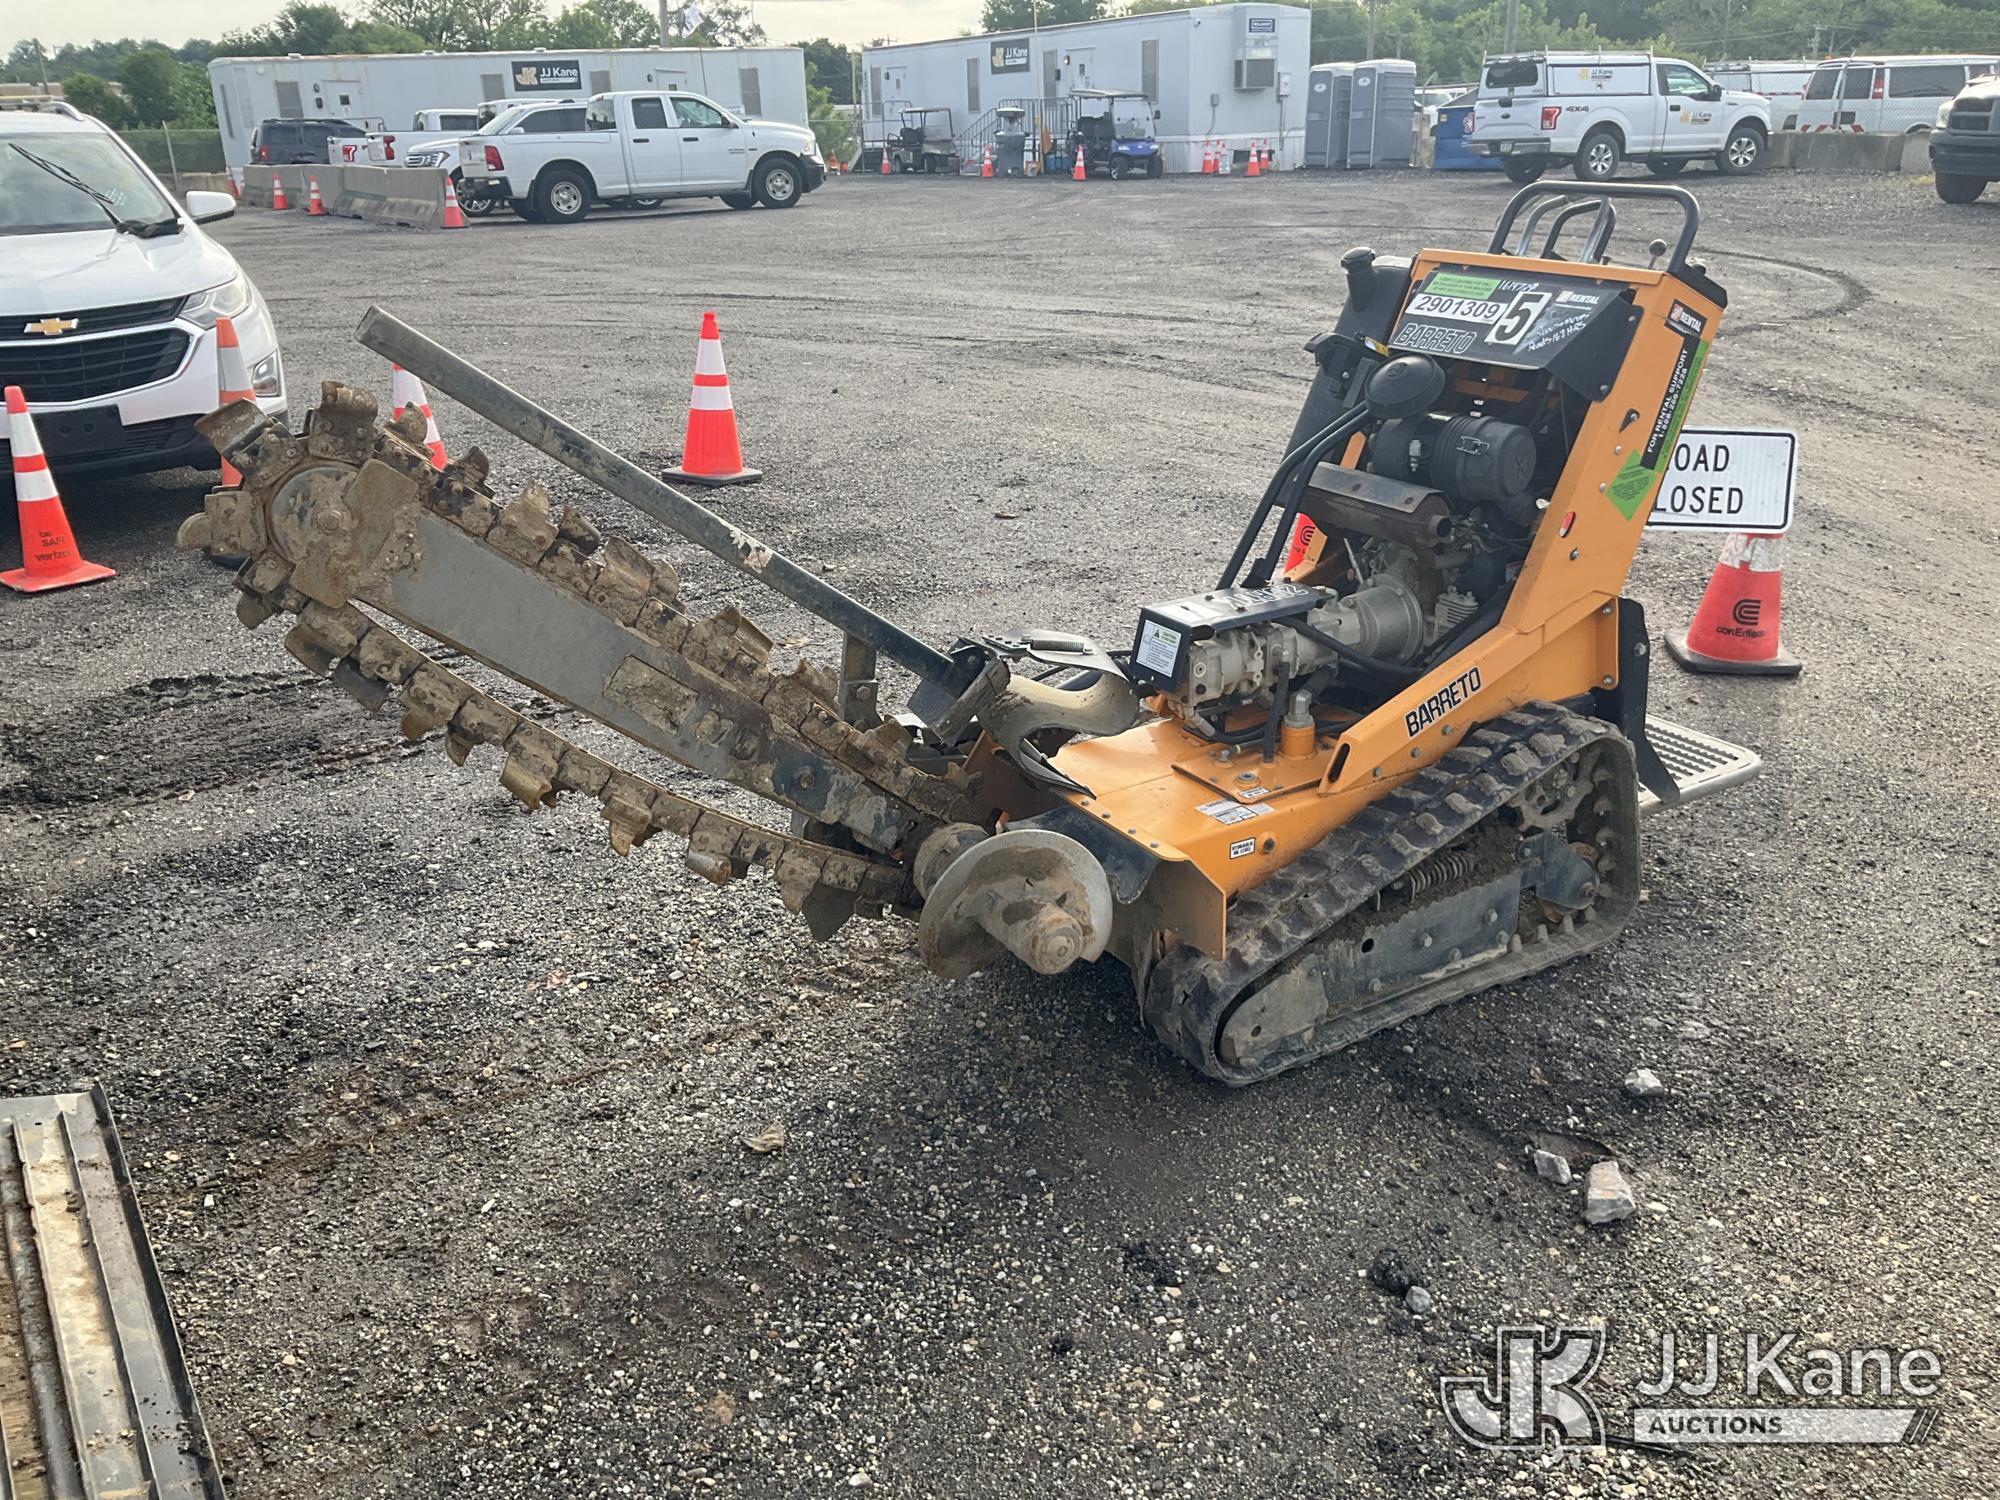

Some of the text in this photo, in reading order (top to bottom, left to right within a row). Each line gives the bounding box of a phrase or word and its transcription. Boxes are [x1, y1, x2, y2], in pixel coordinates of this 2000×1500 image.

[540, 67, 579, 77] JJ Kane
[1414, 295, 1501, 320] 2901309
[1568, 294, 1600, 305] RENTAL
[1495, 293, 1544, 343] 5
[1679, 311, 1702, 333] RENTAL
[1393, 323, 1477, 354] BARRETO
[1647, 433, 1659, 453] FOR
[1655, 395, 1673, 431] RENTAL
[1668, 348, 1688, 393] SUPPORT
[1672, 443, 1730, 472] OAD
[1405, 667, 1482, 738] BARRETO
